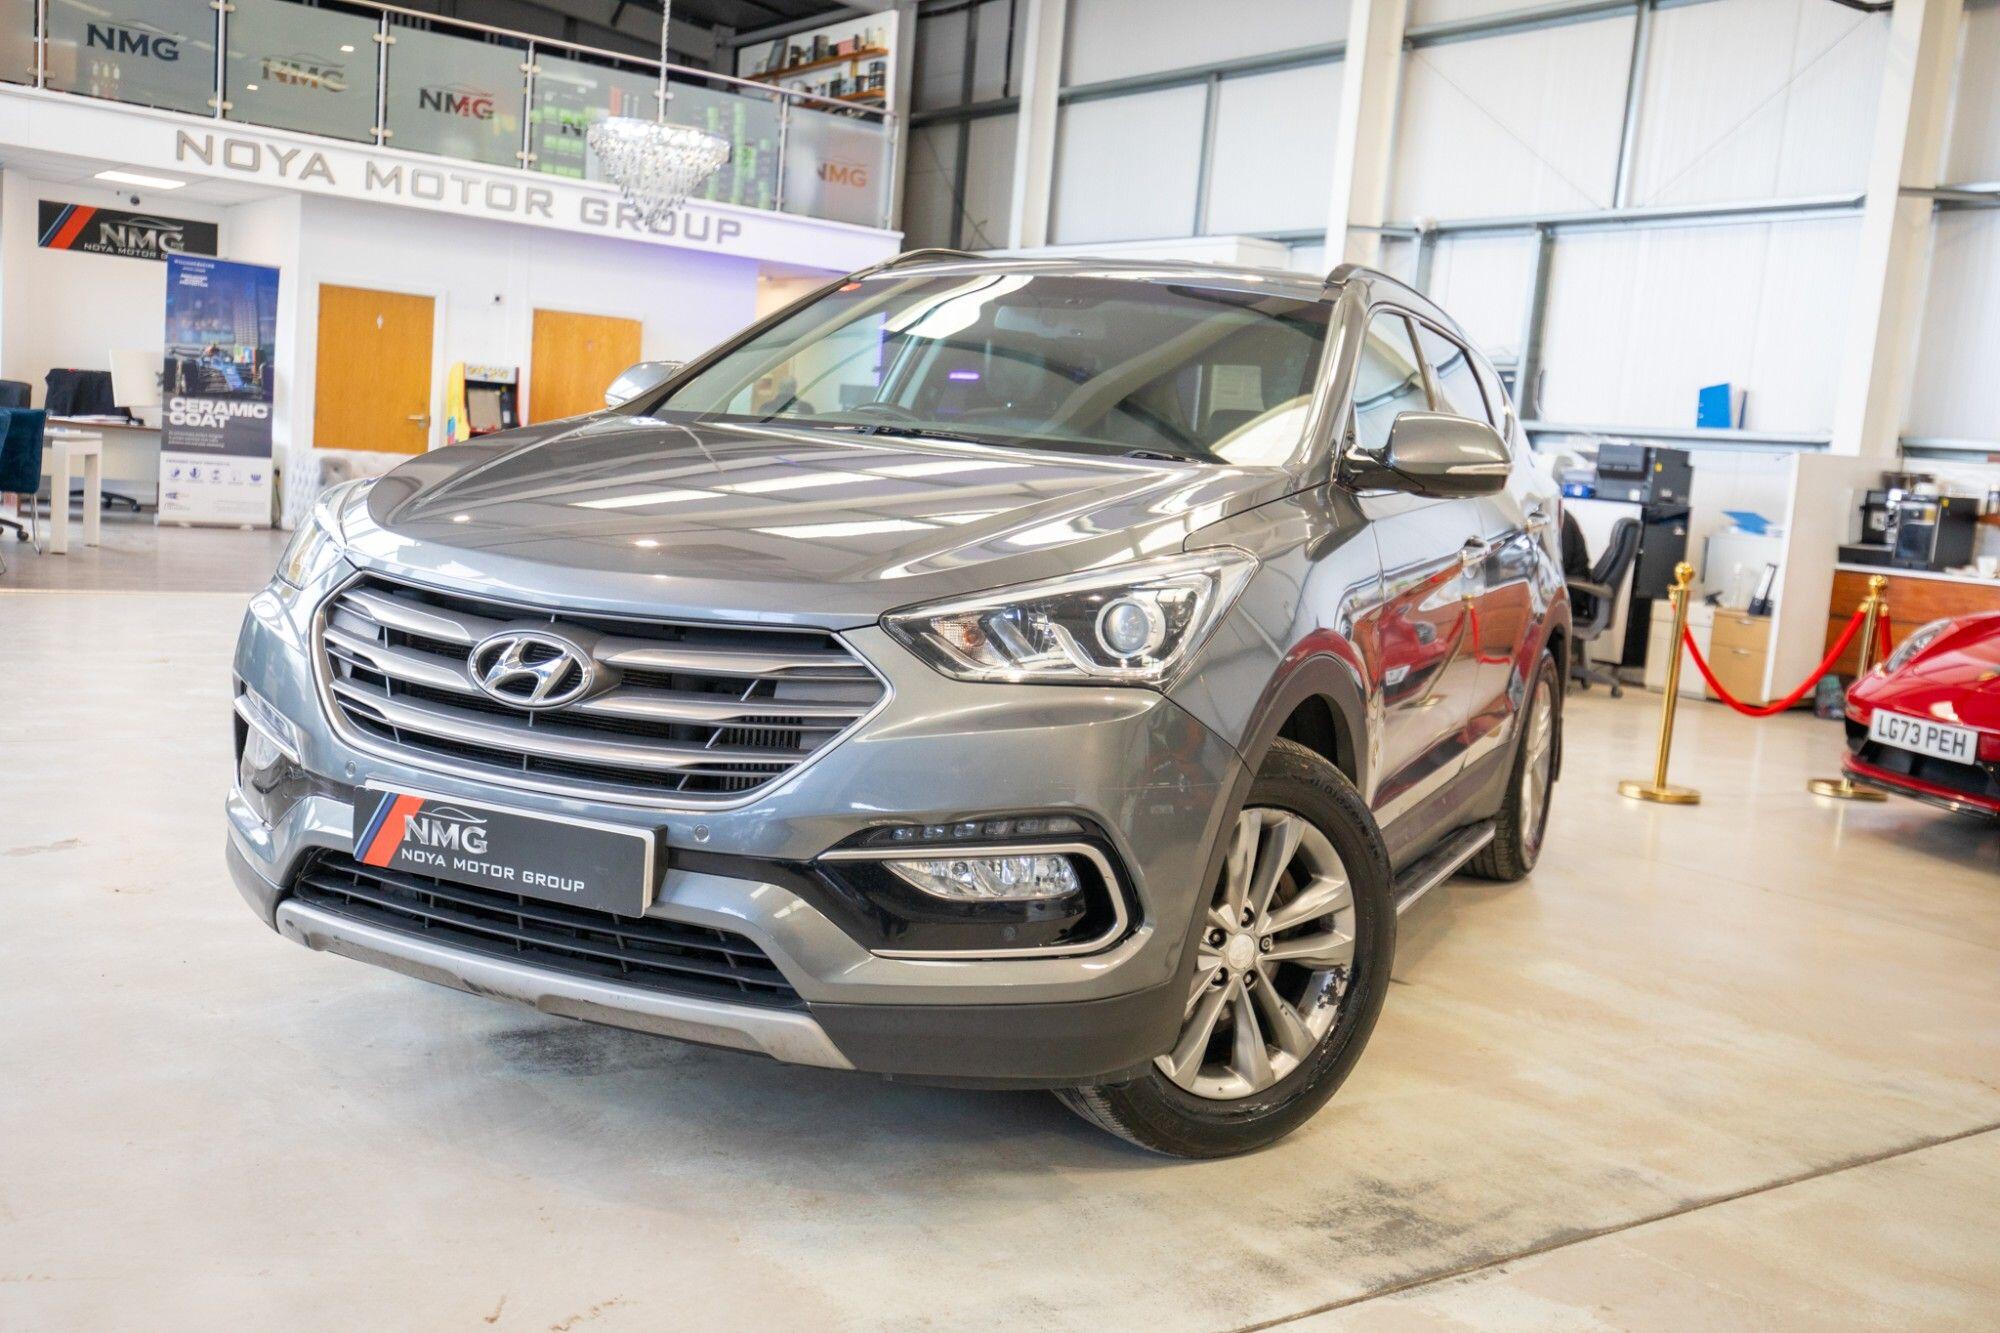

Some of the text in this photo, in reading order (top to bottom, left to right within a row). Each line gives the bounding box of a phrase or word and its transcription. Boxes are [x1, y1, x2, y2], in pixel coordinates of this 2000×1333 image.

[87, 23, 180, 61] NMG
[262, 57, 344, 92] NMG
[419, 87, 495, 120] NMG
[176, 129, 742, 244] NOYA MOTOR GROUP
[83, 242, 114, 254] NOYA
[117, 246, 157, 258] MOTOR
[100, 221, 184, 252] NMG
[169, 397, 268, 419] CERAMIC
[169, 411, 230, 429] COAT
[1878, 714, 1967, 757] LG73 PEH
[403, 814, 488, 854] NMG
[401, 848, 585, 893] NOYA MOTOR GROUP
